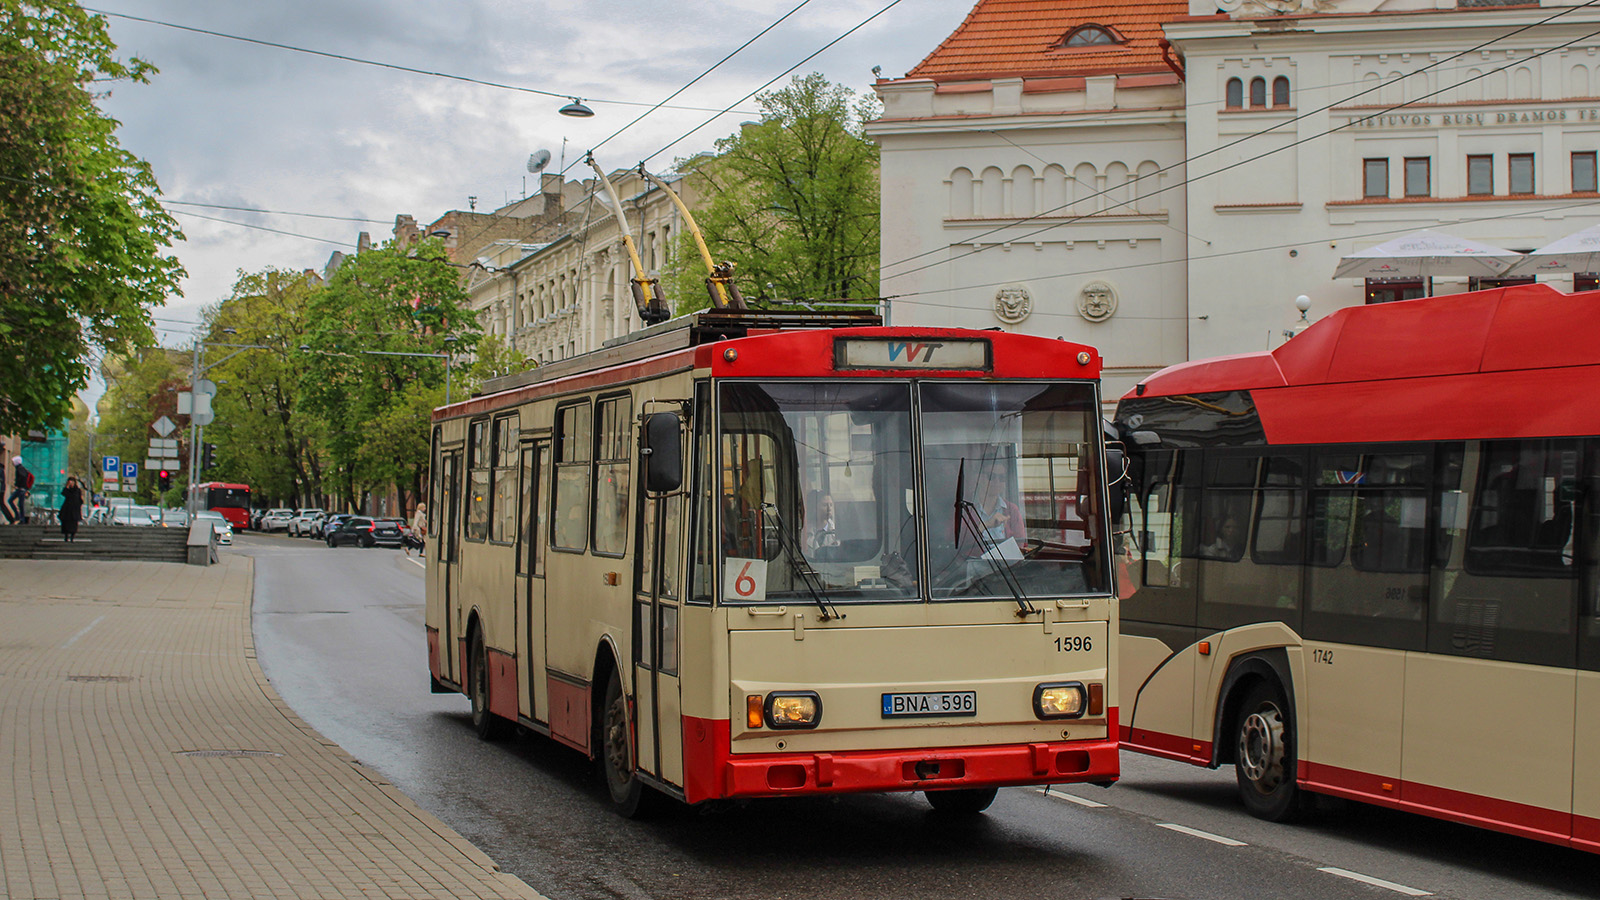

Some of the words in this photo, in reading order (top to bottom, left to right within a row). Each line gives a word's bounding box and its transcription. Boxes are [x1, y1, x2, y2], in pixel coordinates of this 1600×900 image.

[1348, 114, 1431, 127] LIETUVOS
[1443, 112, 1485, 126] RUSŲ
[1496, 110, 1567, 123] DRAMOS
[888, 342, 943, 362] VVT
[106, 458, 116, 471] P
[126, 465, 135, 476] P
[735, 561, 756, 597] 6
[1054, 636, 1092, 652] 1596
[1312, 648, 1334, 665] 1742
[894, 696, 931, 712] BNA
[942, 694, 972, 711] 596
